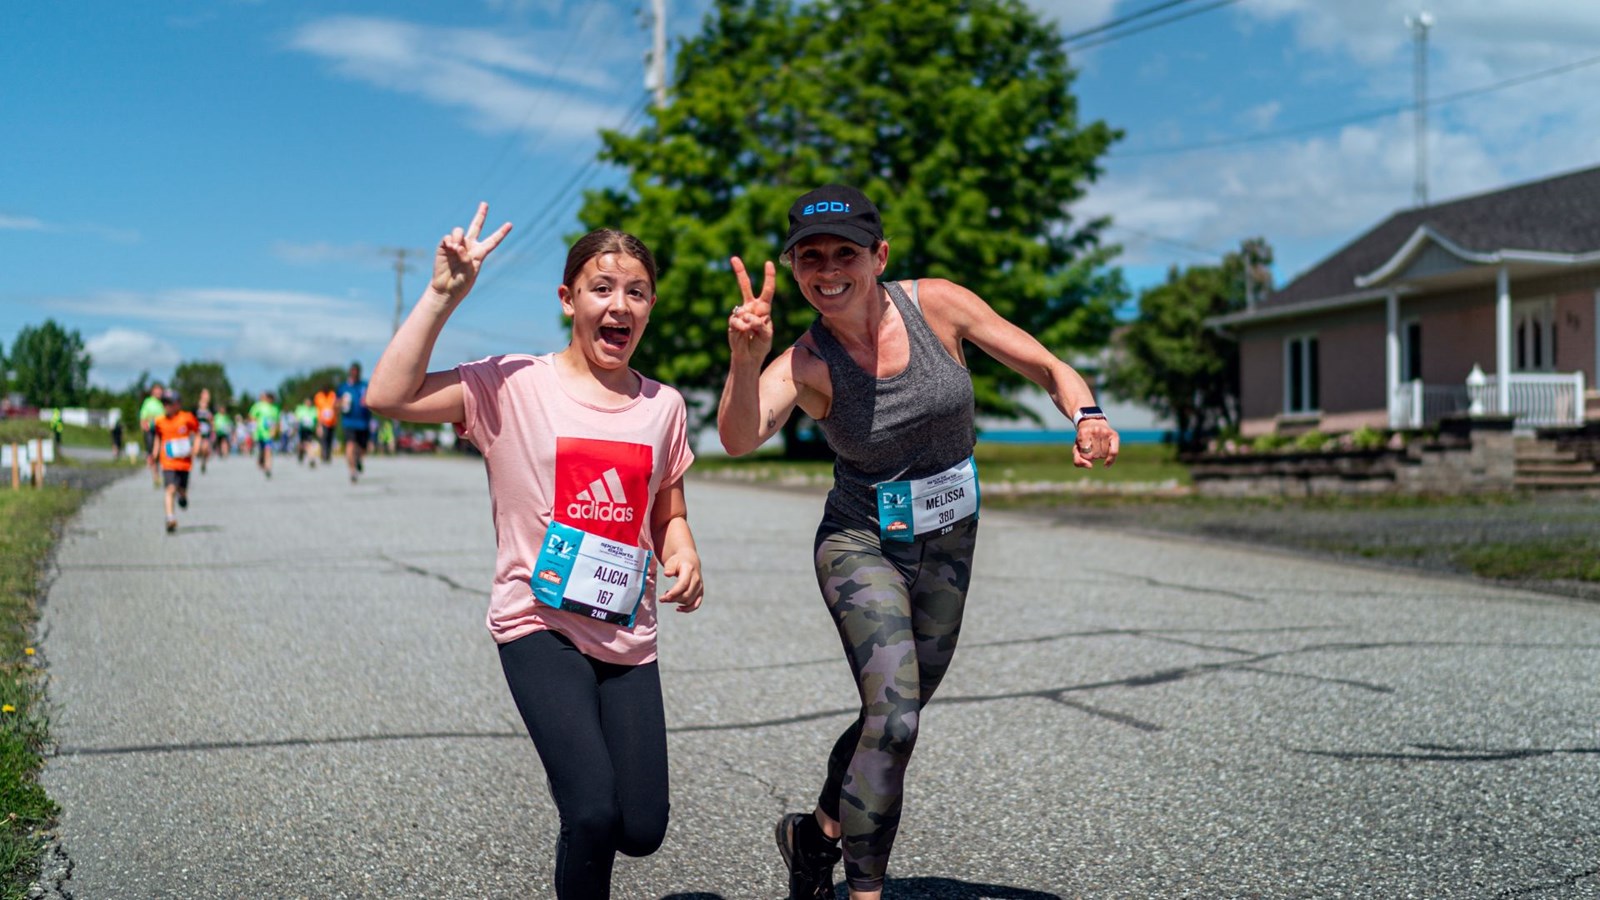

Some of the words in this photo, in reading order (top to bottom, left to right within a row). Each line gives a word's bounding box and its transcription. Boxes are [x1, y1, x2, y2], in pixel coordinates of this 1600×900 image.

[926, 487, 965, 510] MÉLISSA
[567, 501, 633, 522] adidas
[939, 509, 955, 524] 380
[594, 566, 628, 588] ALICIA
[596, 590, 614, 605] 167
[592, 610, 597, 618] 2
[597, 611, 608, 619] KM
